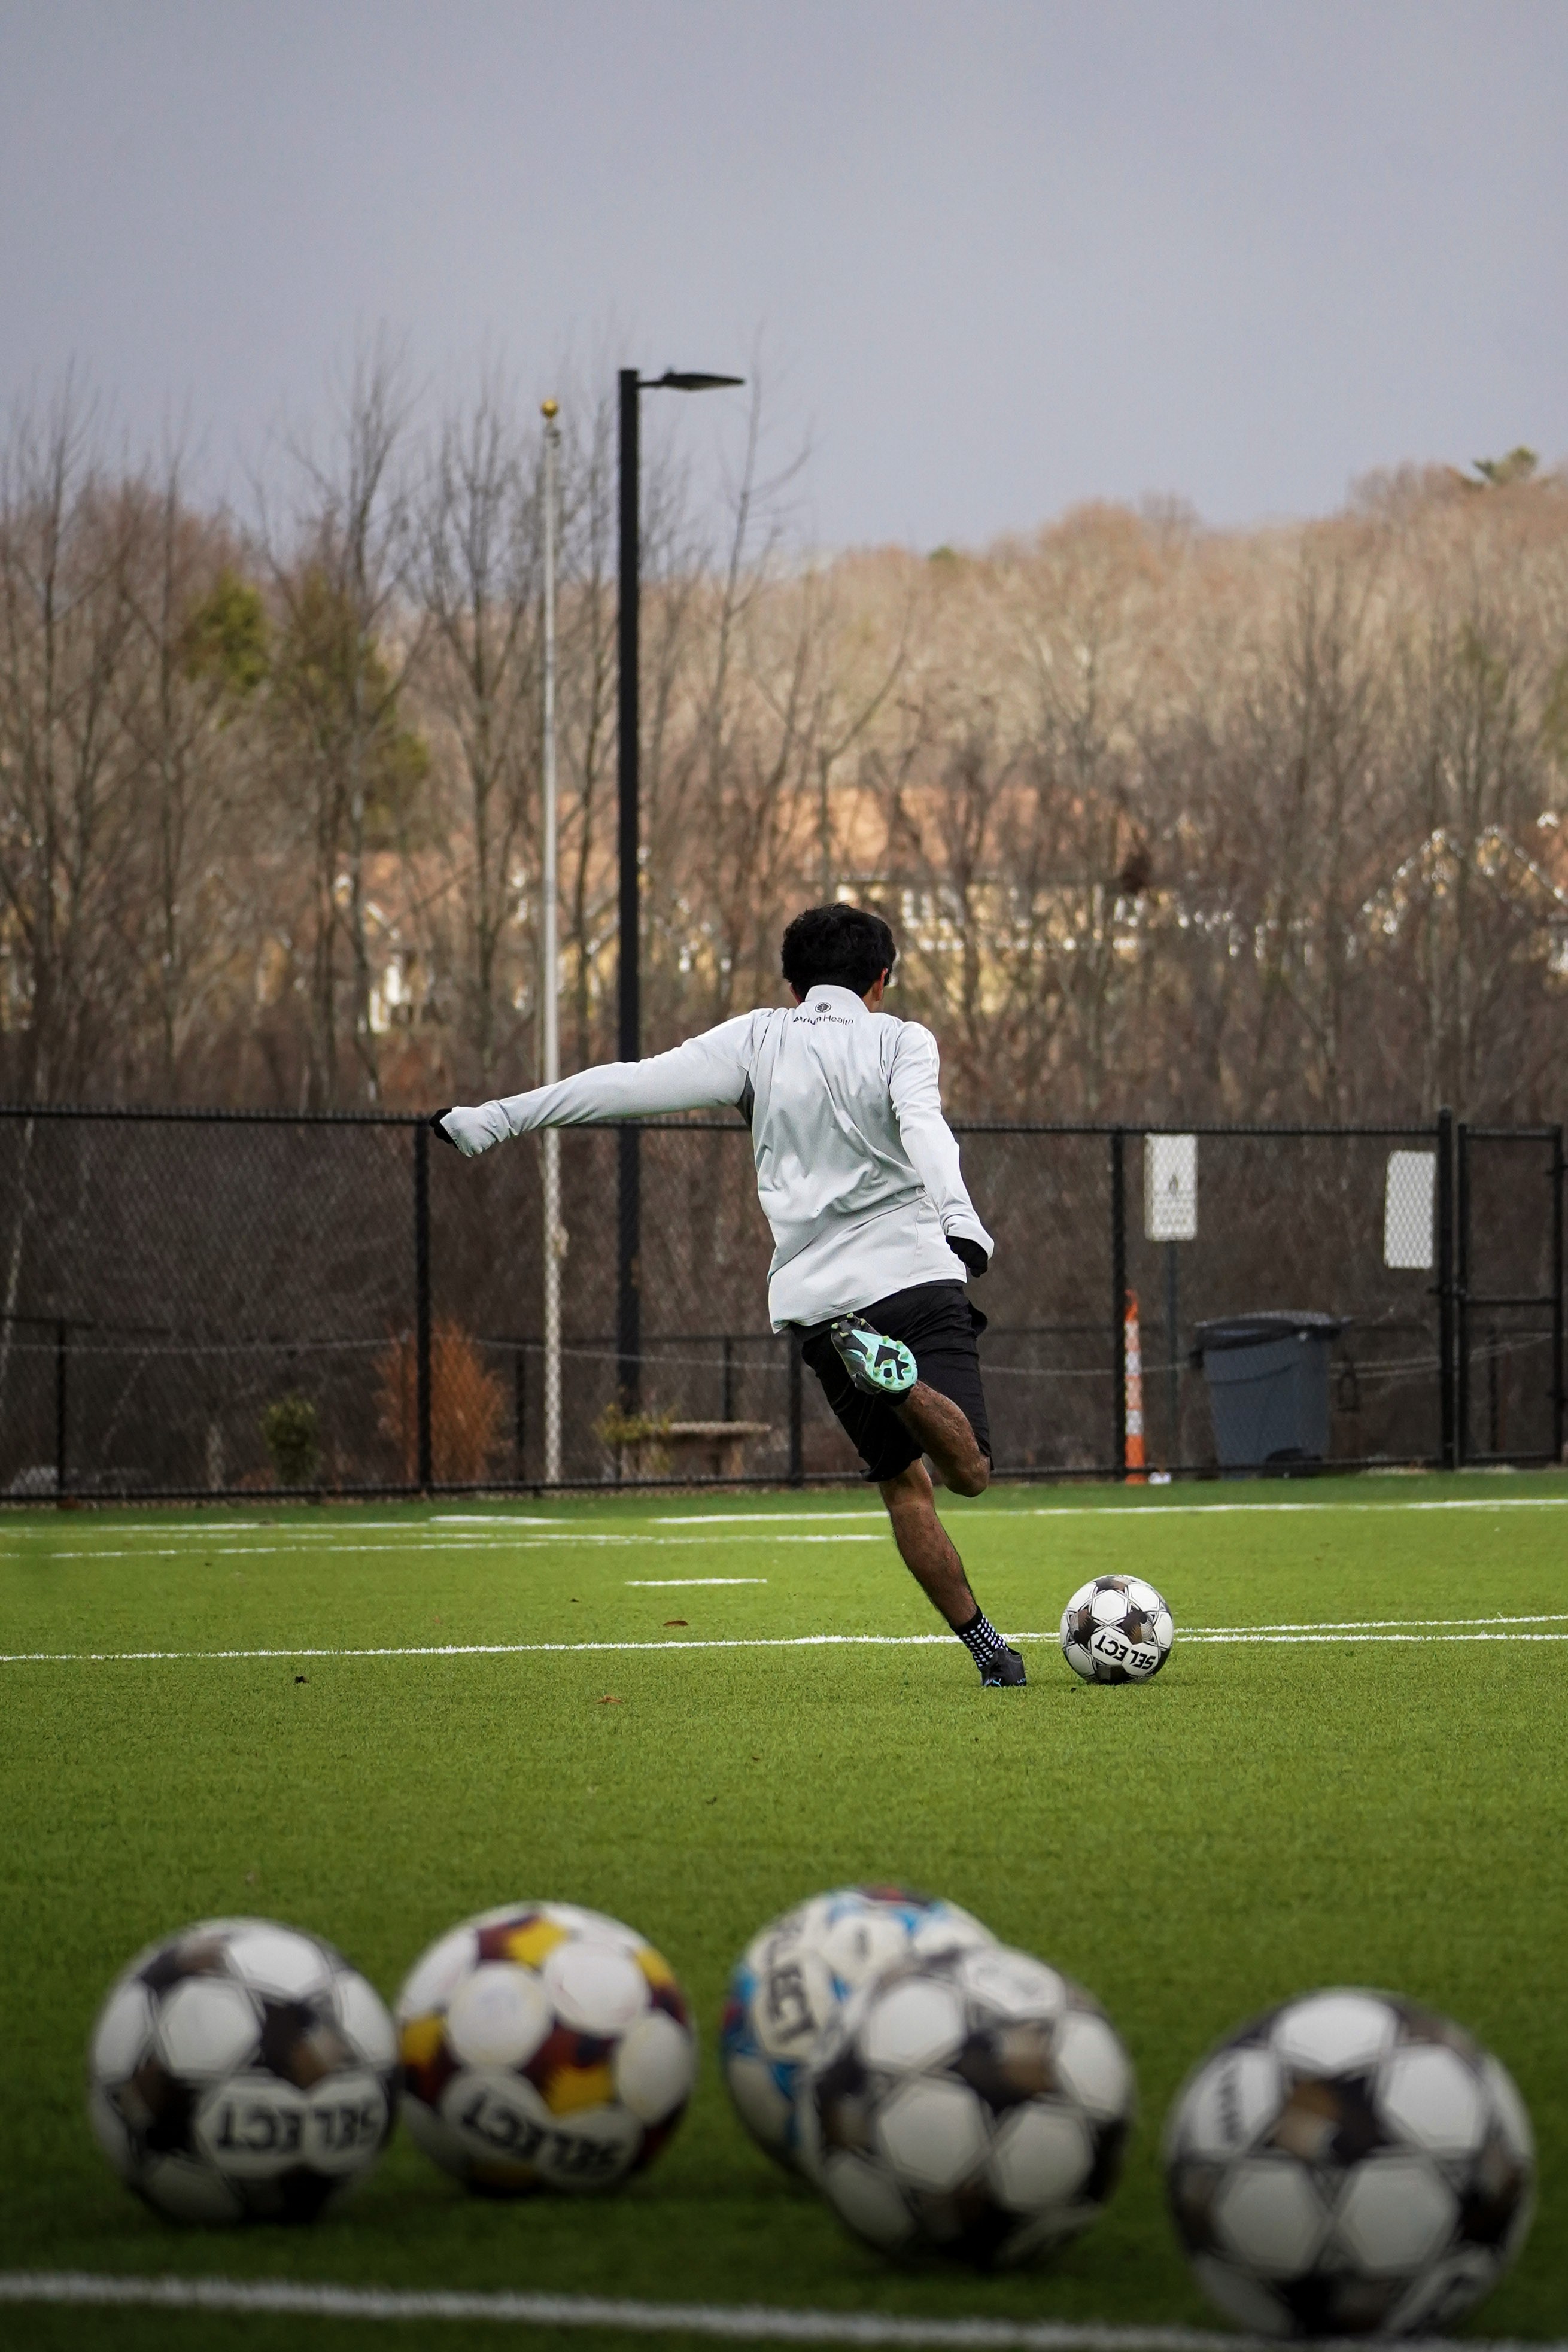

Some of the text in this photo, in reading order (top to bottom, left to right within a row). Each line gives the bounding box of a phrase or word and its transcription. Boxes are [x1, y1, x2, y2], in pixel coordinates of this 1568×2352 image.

[823, 1014, 853, 1025] Health
[1095, 1634, 1156, 1670] SELECT
[216, 2099, 379, 2151] SELECT
